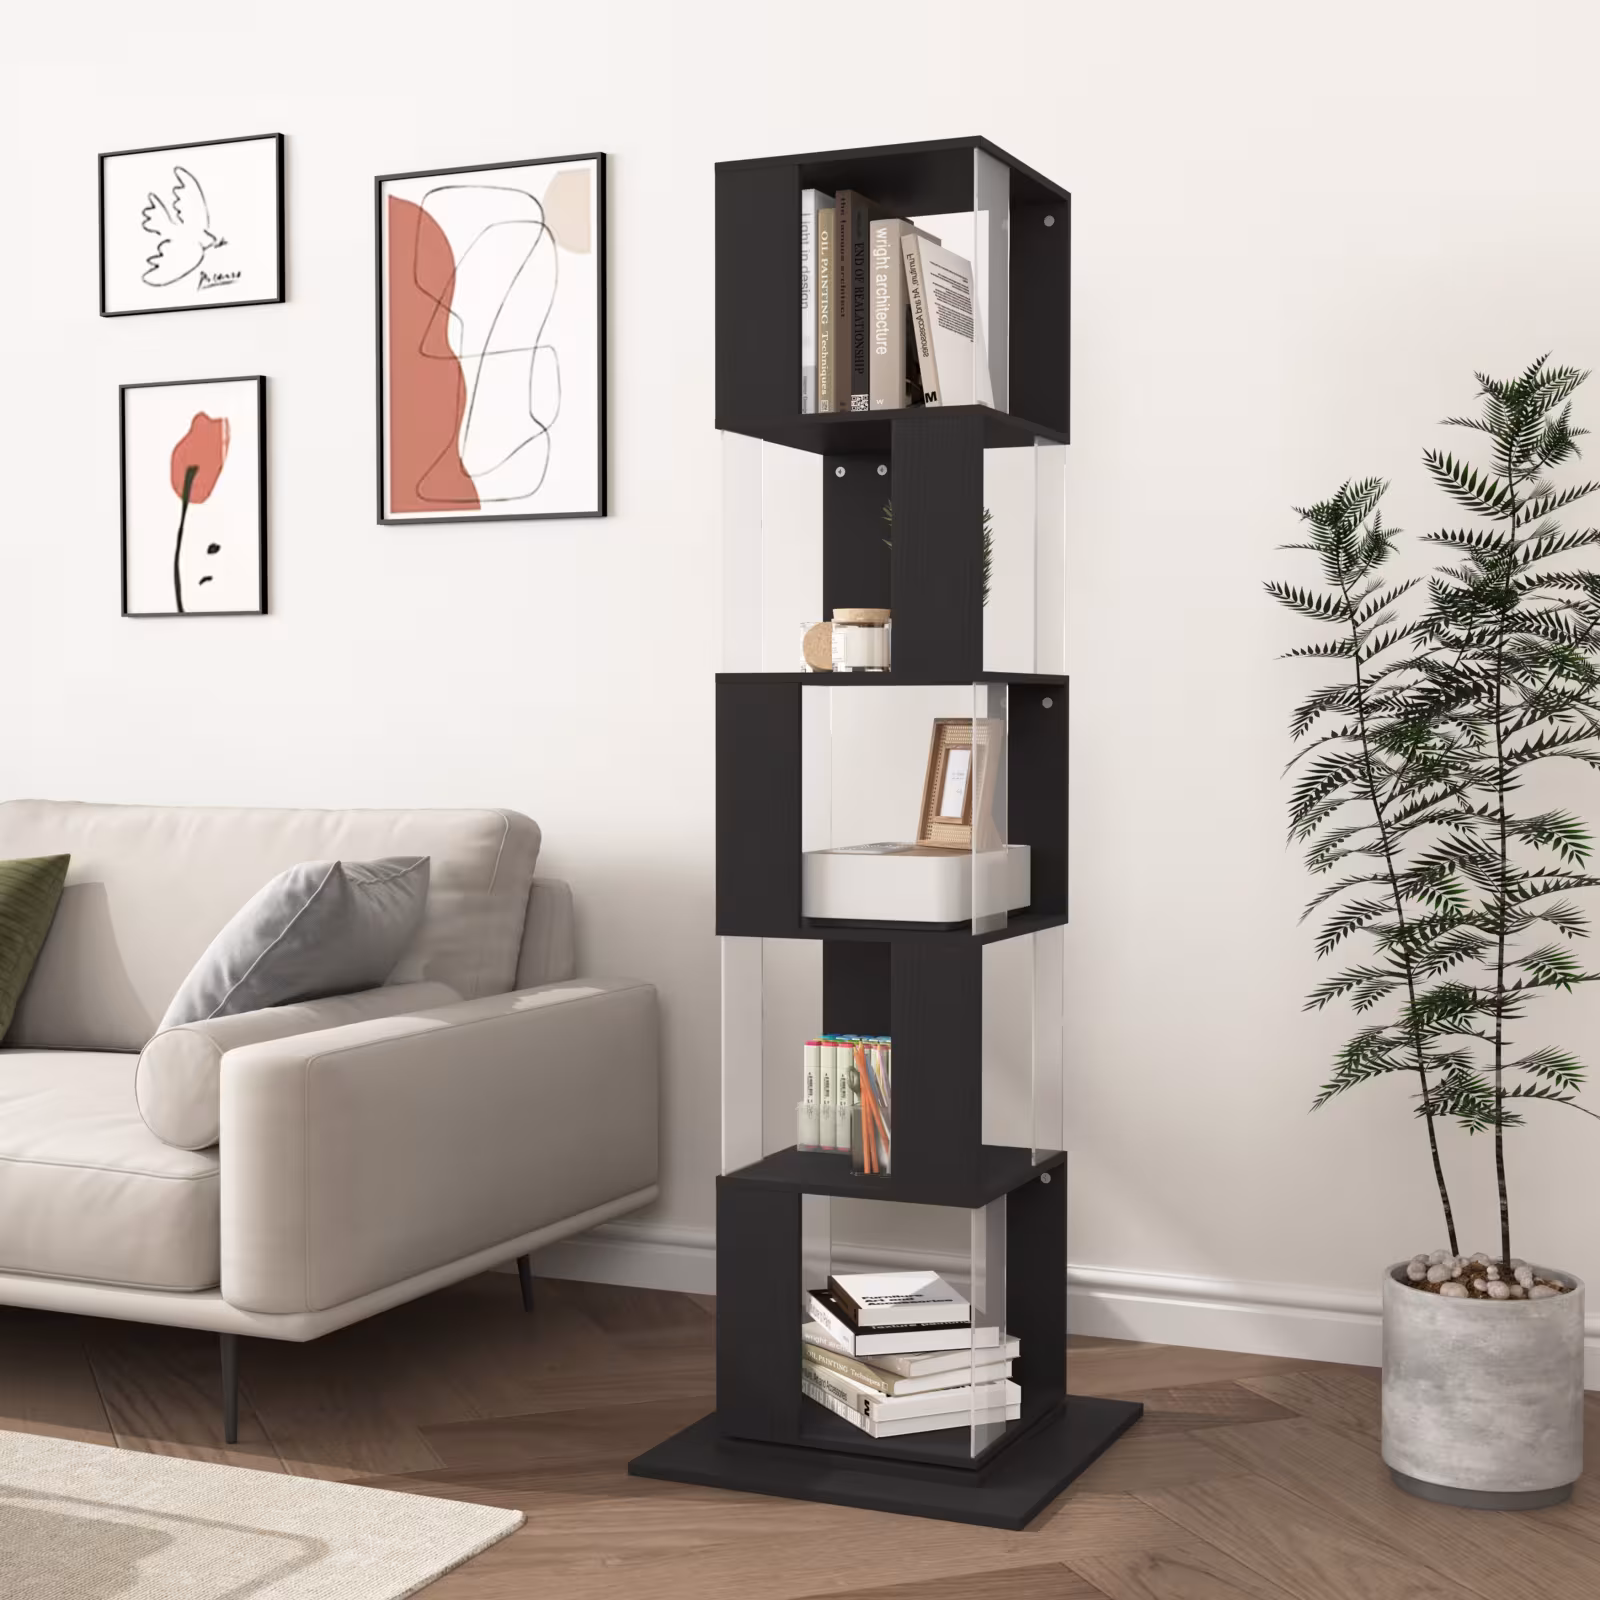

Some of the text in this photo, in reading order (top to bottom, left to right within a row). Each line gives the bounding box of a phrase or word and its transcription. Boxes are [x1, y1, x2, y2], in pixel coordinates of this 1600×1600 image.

[854, 242, 865, 266] END
[854, 269, 865, 284] OF
[873, 227, 891, 355] wright architecture
[819, 230, 829, 395] OIL PAINTING Techniques
[924, 391, 938, 403] M
[818, 1354, 849, 1373] PAINTING
